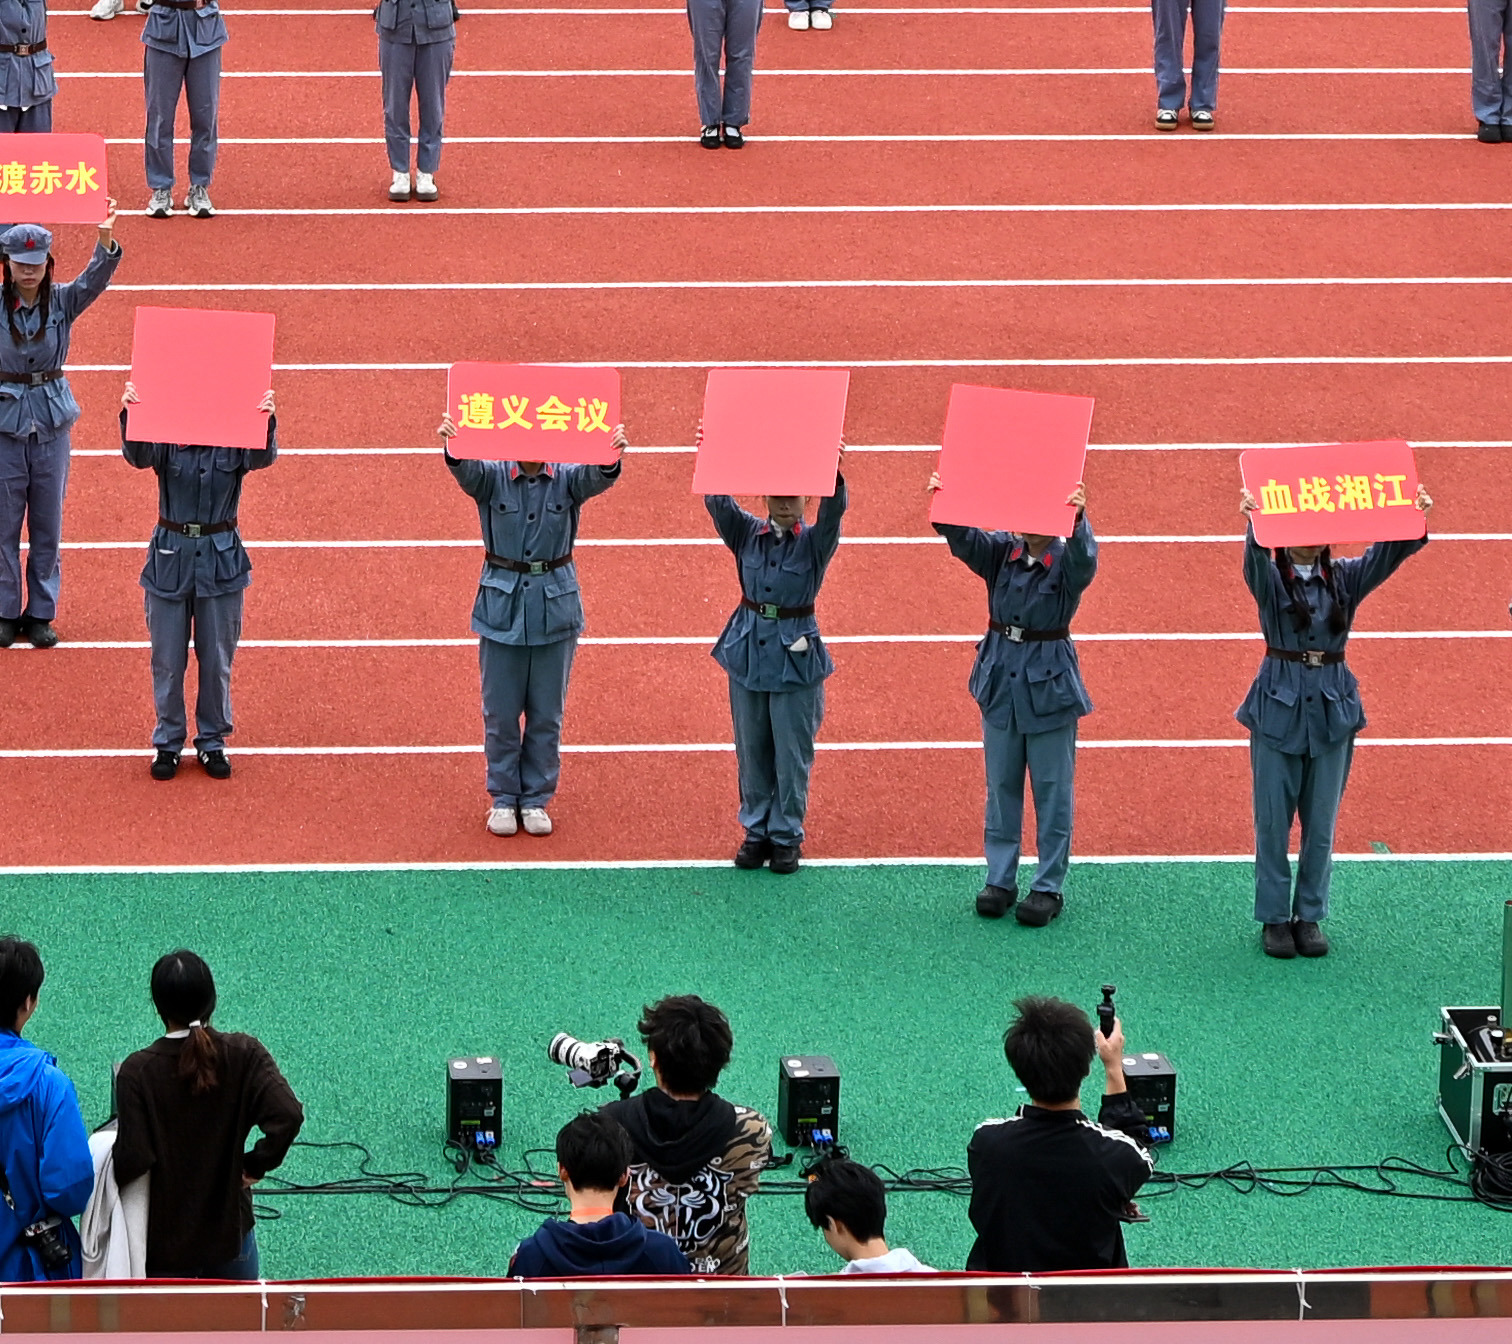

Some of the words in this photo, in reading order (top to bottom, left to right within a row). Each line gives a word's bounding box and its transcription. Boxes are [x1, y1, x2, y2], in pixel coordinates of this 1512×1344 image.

[457, 392, 611, 434] 遵义会议
[1260, 472, 1414, 516] 血战湘江
